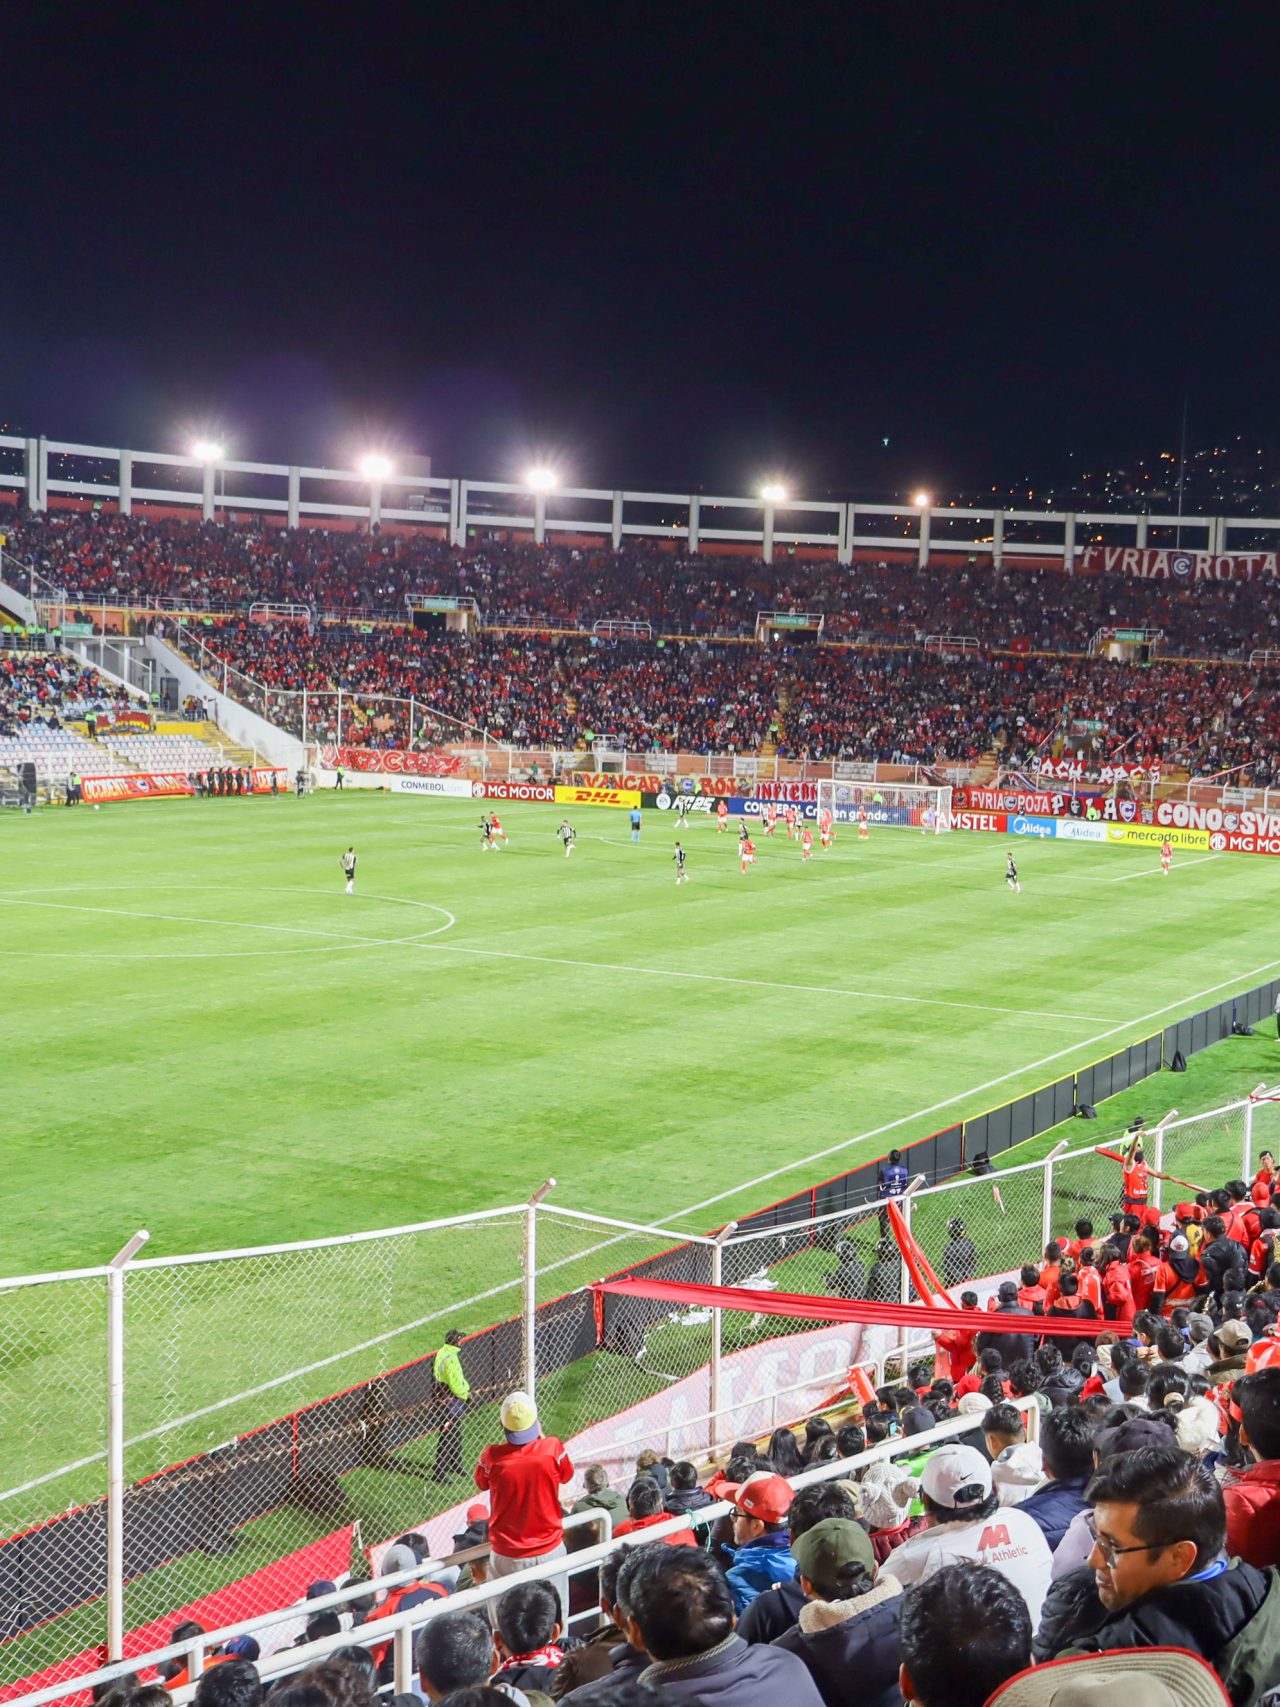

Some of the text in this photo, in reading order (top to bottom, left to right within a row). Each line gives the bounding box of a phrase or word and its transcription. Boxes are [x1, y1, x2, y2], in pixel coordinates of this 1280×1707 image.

[488, 784, 554, 800] MG MOTOR
[575, 790, 621, 804] DHL
[937, 812, 997, 831] AMSTEL
[1157, 802, 1222, 831] CONO
[1019, 821, 1051, 835] Midea
[1069, 825, 1101, 838] Midea
[1127, 829, 1207, 846] mercado libre
[1229, 837, 1253, 850] MG
[992, 1544, 1029, 1563] Athletic
